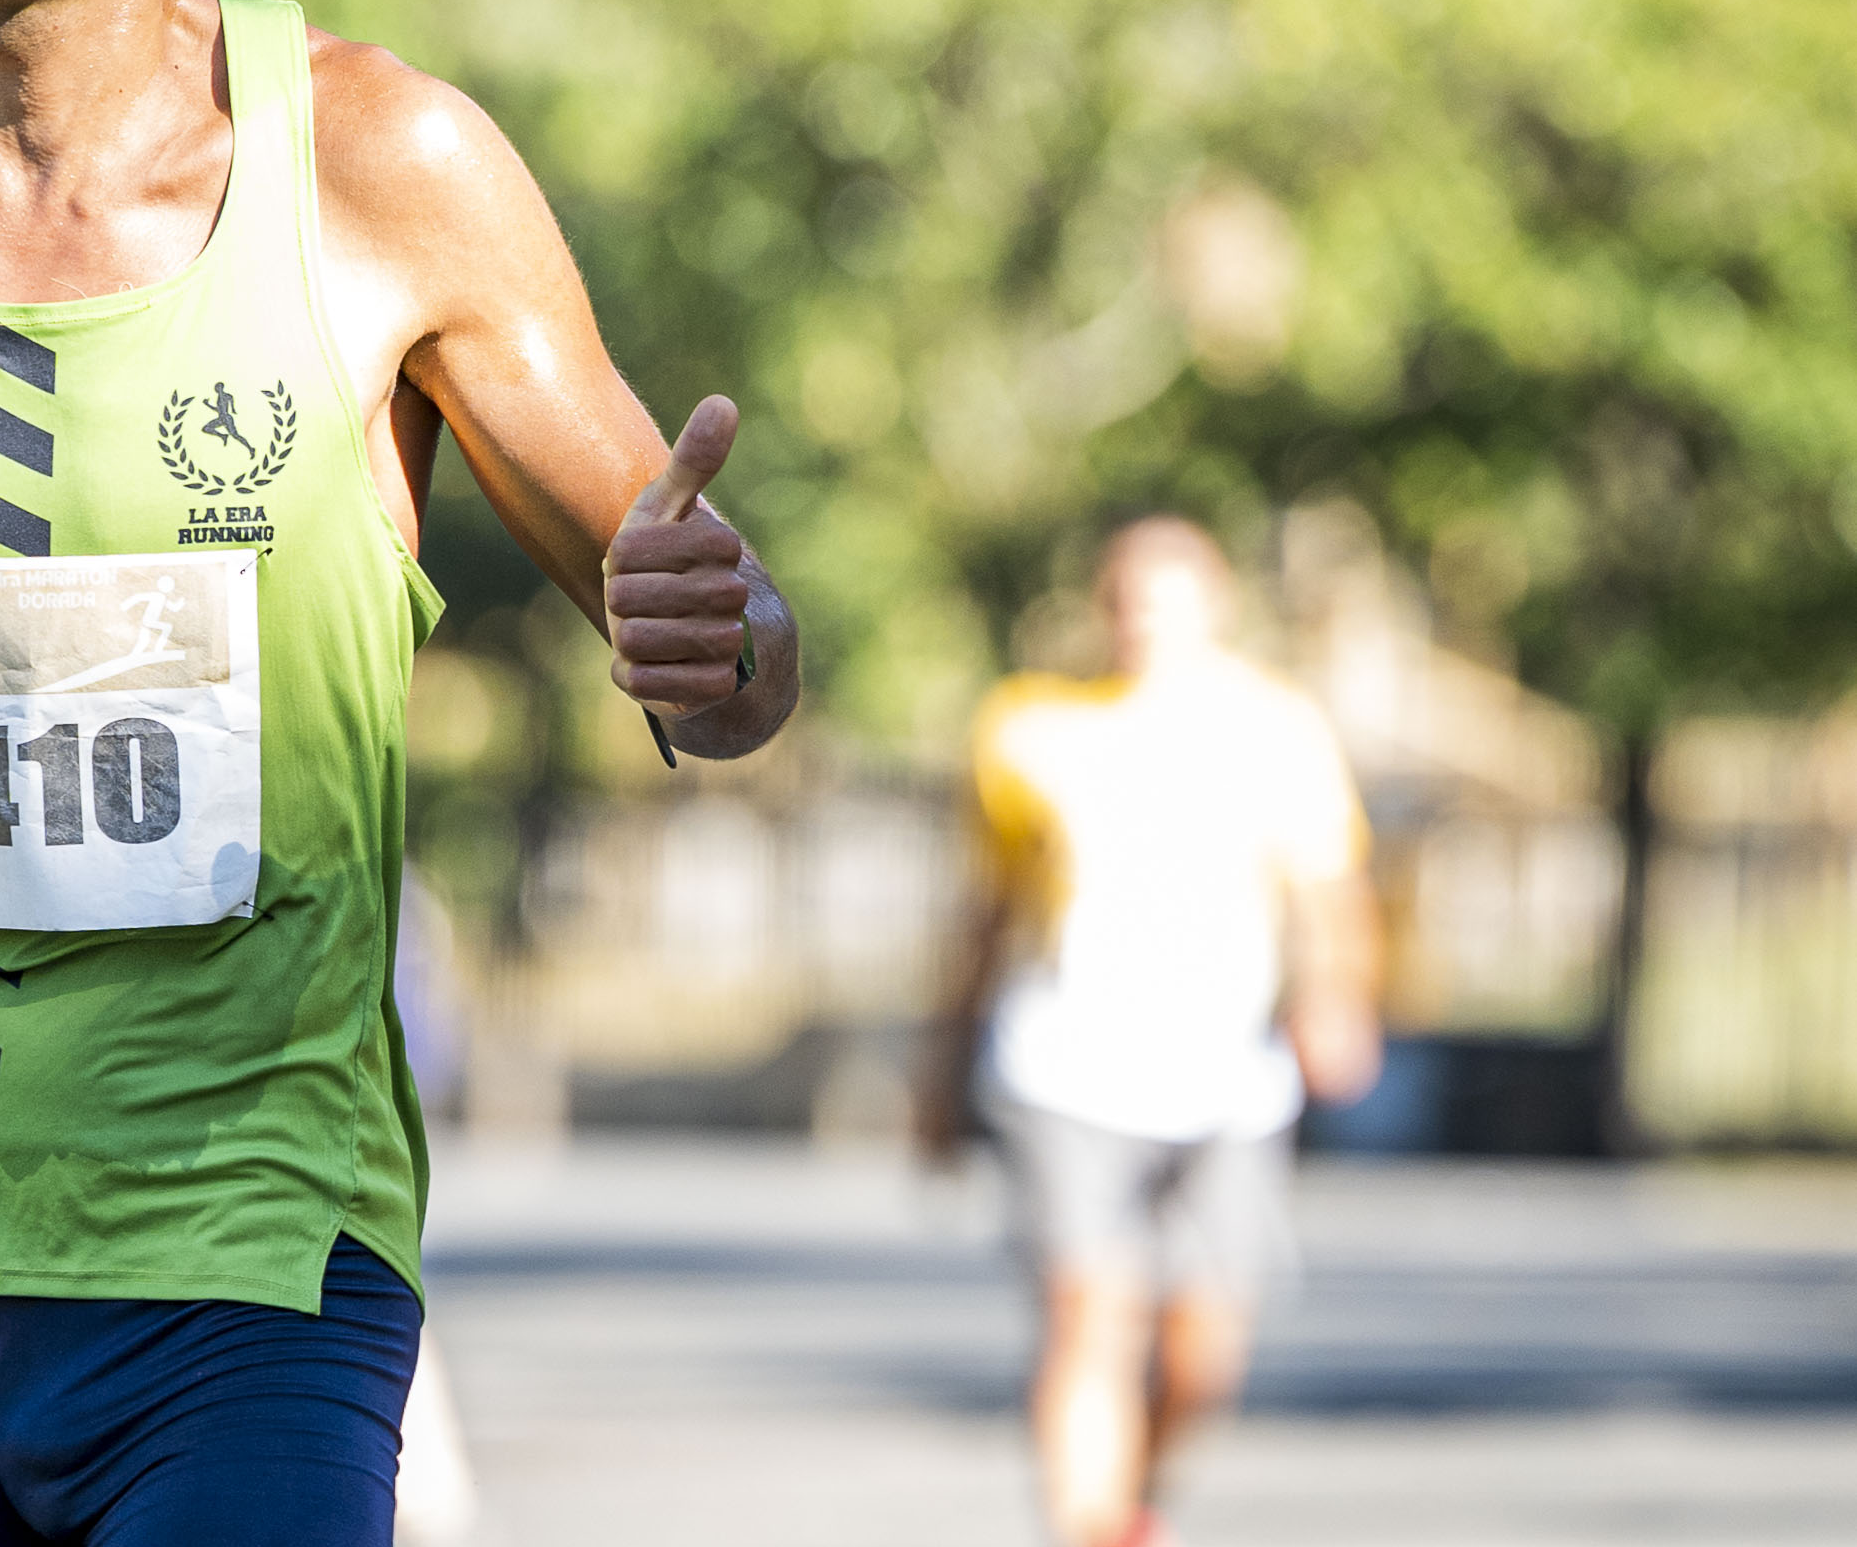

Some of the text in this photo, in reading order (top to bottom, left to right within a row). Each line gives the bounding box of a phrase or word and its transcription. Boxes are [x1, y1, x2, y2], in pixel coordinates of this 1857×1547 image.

[188, 505, 267, 524] LA ERA
[177, 525, 274, 544] RUNNING
[17, 591, 96, 609] DORADA
